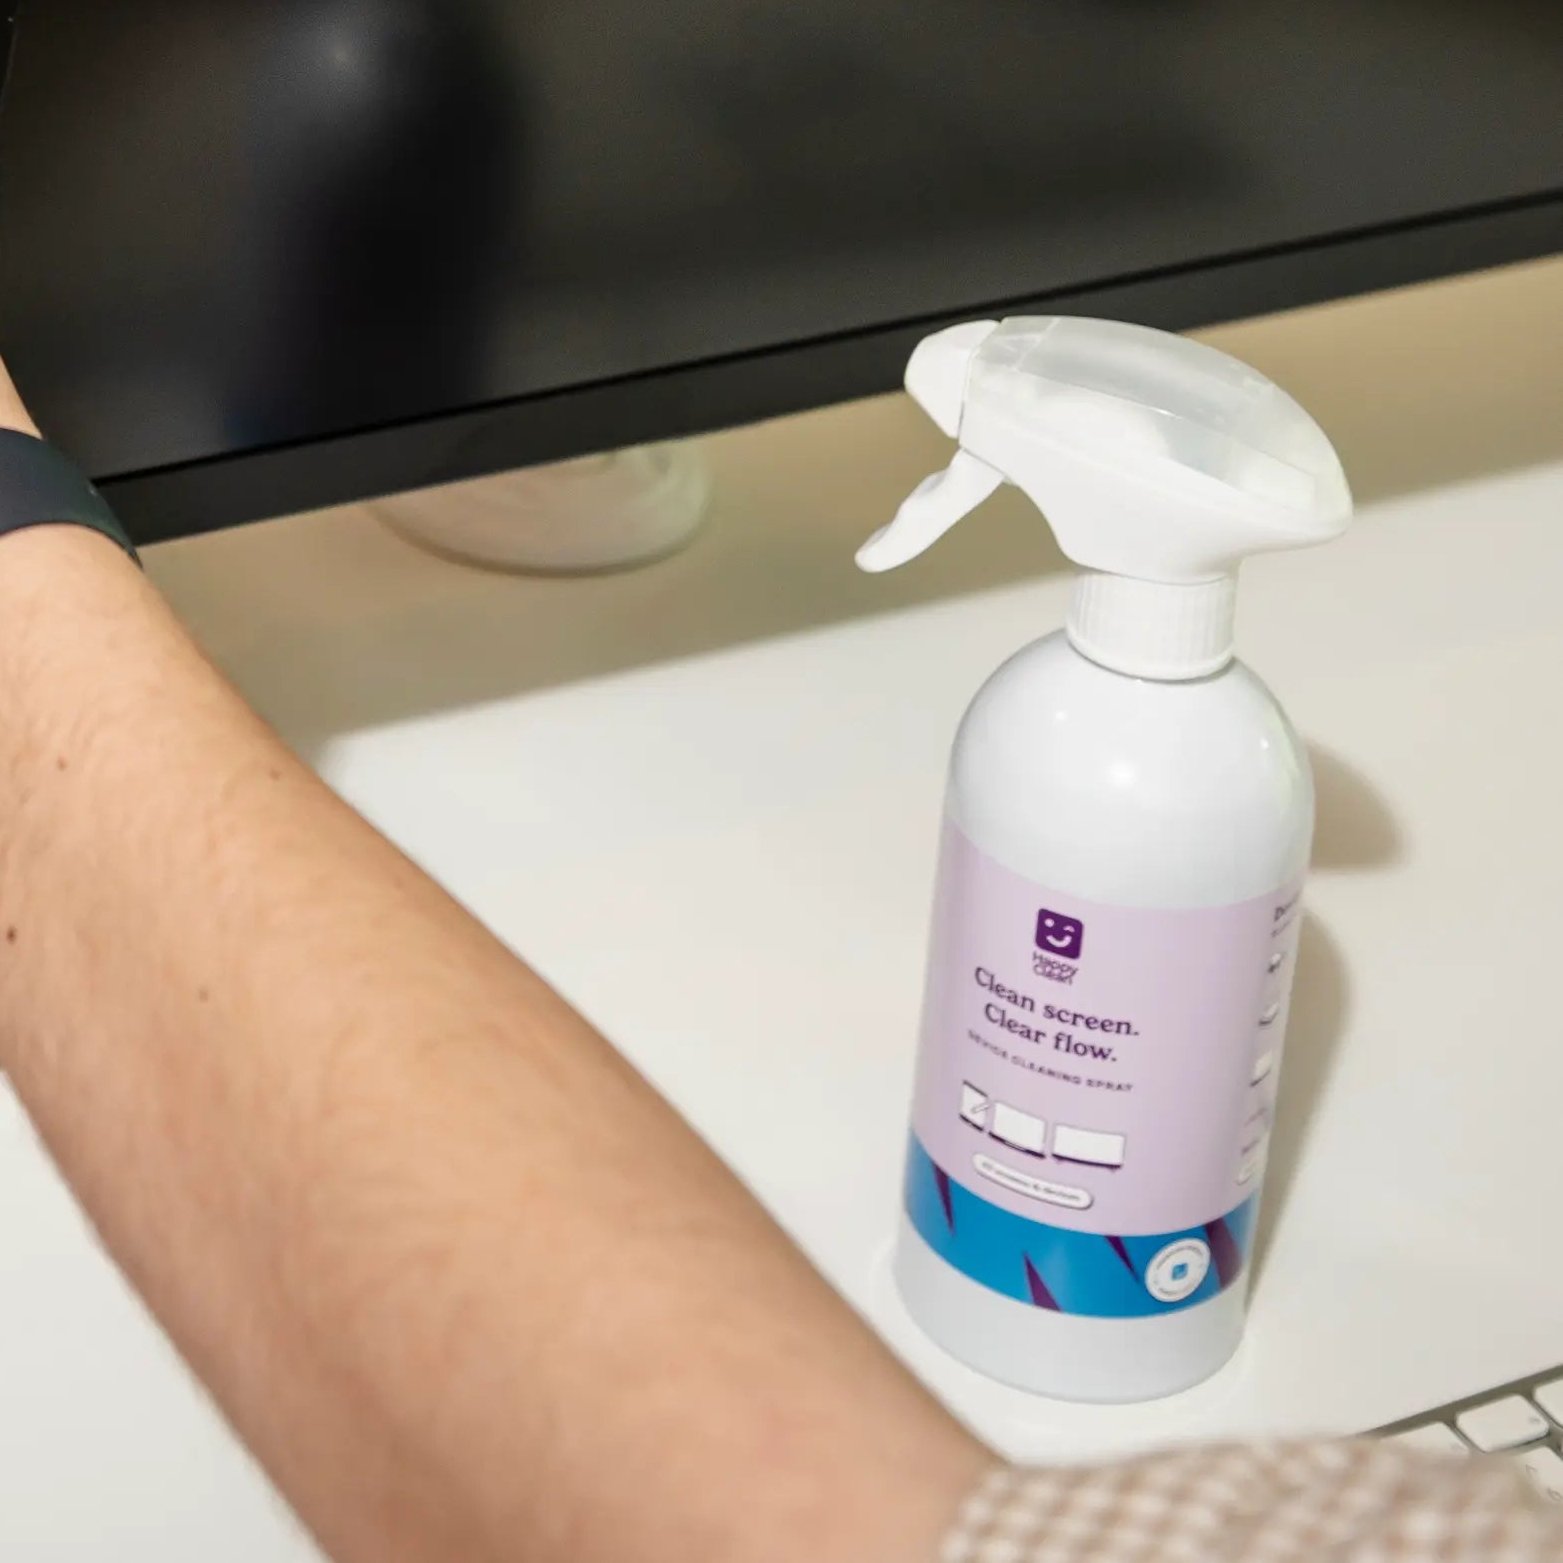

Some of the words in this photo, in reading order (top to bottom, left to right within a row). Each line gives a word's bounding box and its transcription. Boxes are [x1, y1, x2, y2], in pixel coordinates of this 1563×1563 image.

[975, 966, 1035, 1012] Clean
[1044, 1005, 1139, 1036] screen.
[984, 1003, 1046, 1043] Clear
[1054, 1032, 1117, 1062] flow.
[1011, 1056, 1081, 1085] CLEANING
[1085, 1078, 1133, 1091] SPRAY
